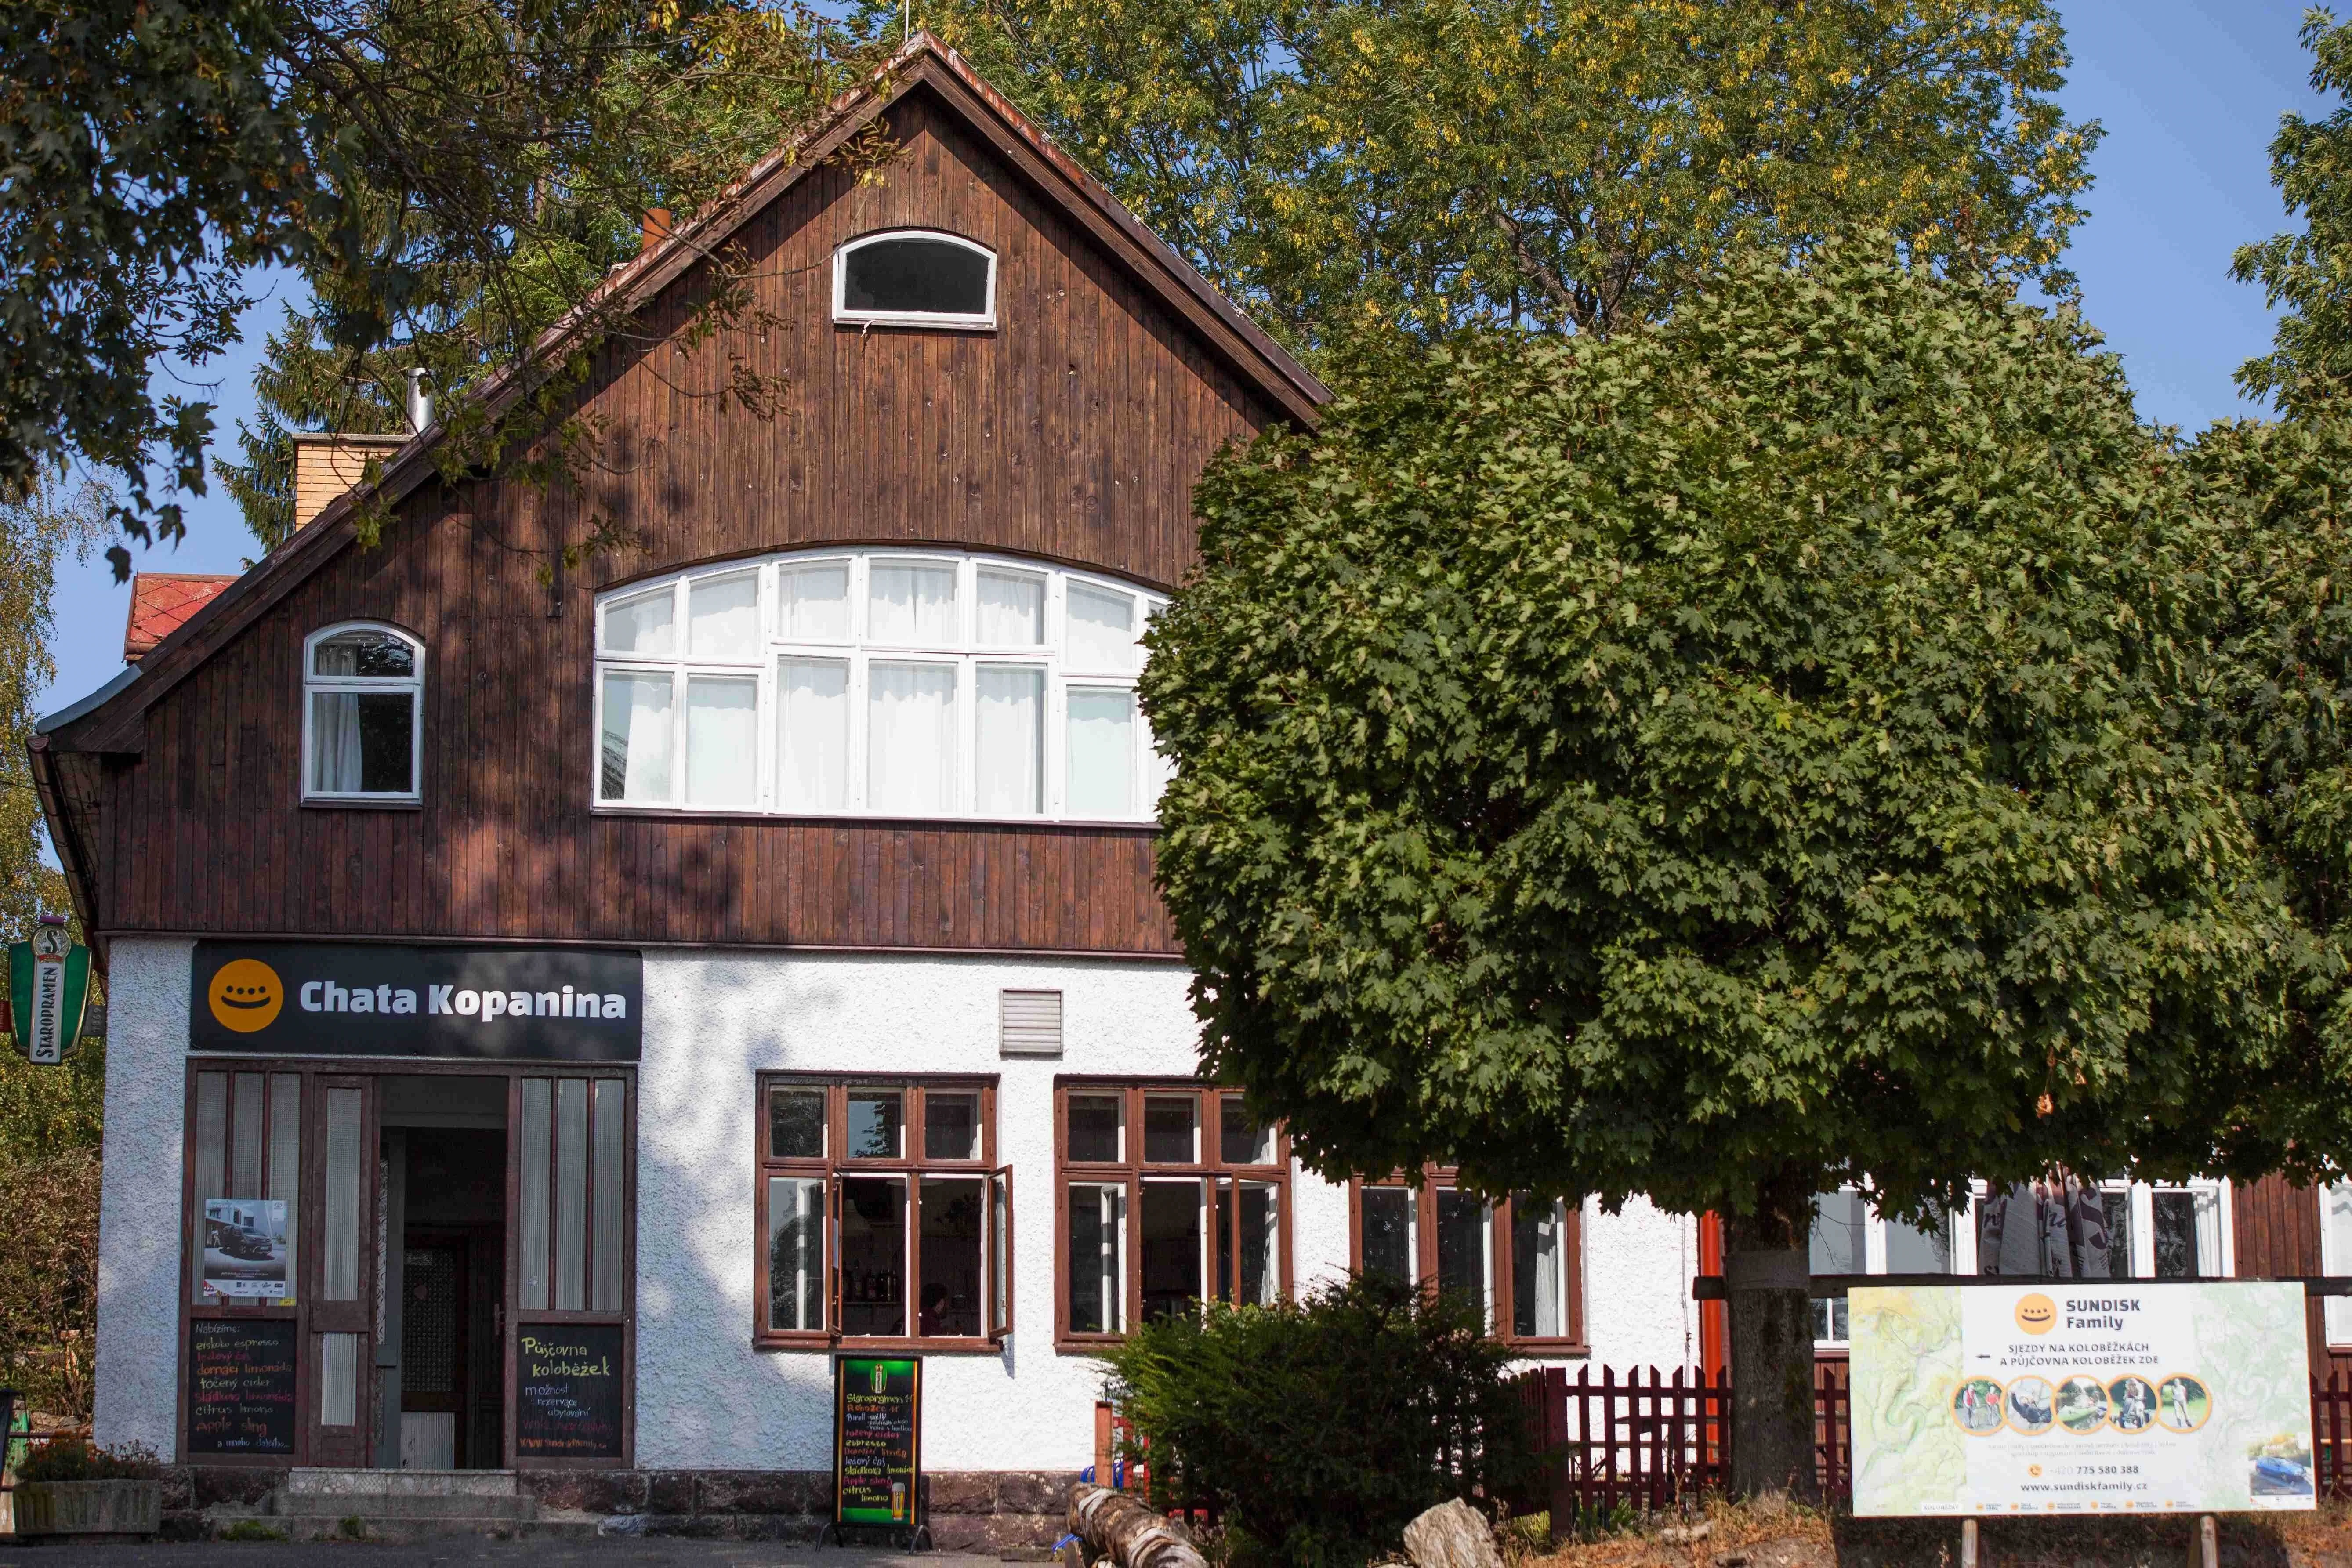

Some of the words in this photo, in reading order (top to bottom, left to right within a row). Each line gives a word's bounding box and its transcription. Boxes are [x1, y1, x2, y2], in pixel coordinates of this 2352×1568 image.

[300, 980, 417, 1014] Chata
[428, 984, 626, 1022] Kopanina
[36, 967, 58, 1058] STAROPRAMEN
[2066, 1299, 2141, 1312] SUNDISK
[2066, 1315, 2124, 1331] Family
[234, 1339, 279, 1350] espresso
[522, 1337, 587, 1358] Půjčovna
[2008, 1343, 2046, 1354] SJEZDY
[2049, 1344, 2066, 1353] NA
[2069, 1341, 2149, 1353] KOLOBĚŽKÁCH
[532, 1356, 611, 1377] koloběžek
[2000, 1357, 2007, 1365] A
[2011, 1354, 2069, 1367] PŮJČOVNA
[2073, 1354, 2135, 1365] KOLOBĚŽEK
[2139, 1356, 2159, 1364] ZDE
[200, 1376, 239, 1391] točený
[243, 1376, 271, 1387] cider
[196, 1404, 232, 1416] citrus
[2077, 1466, 2095, 1474] 775
[2098, 1465, 2116, 1474] 580
[2120, 1465, 2139, 1474] 388
[2020, 1480, 2148, 1492] www.sundiskfamily.cz
